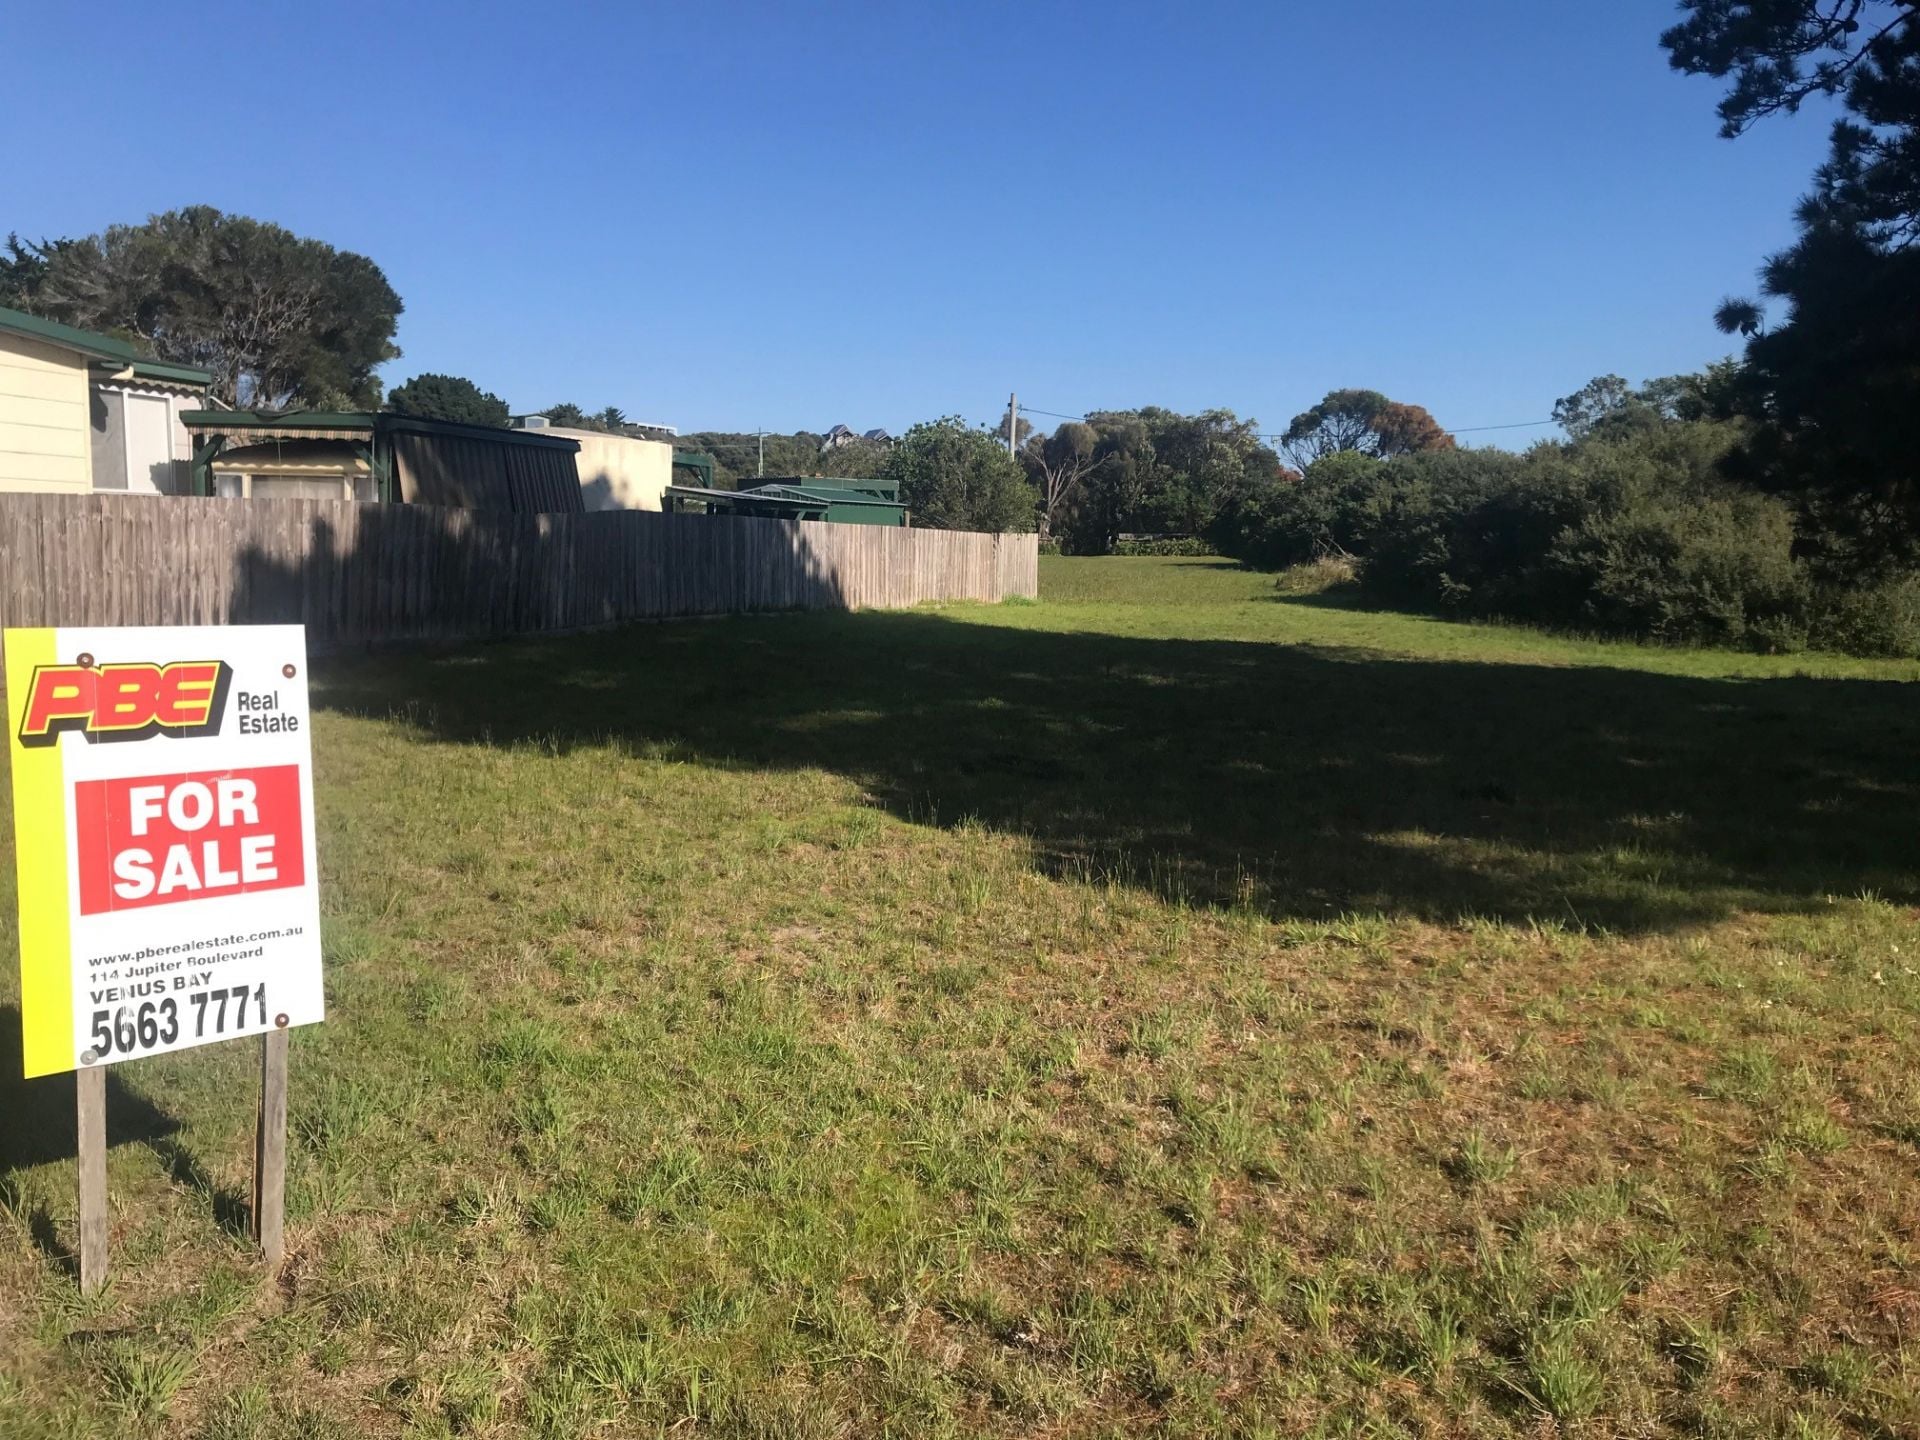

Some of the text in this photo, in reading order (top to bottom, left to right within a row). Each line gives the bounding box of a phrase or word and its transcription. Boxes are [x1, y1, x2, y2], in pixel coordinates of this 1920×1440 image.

[18, 660, 233, 748] PBE
[237, 690, 279, 712] Real
[239, 712, 299, 735] Estate
[129, 778, 260, 837] FOR
[112, 834, 279, 900] SALE
[88, 926, 304, 967] www.pberealestate.com.au
[89, 946, 264, 984] 114 Jupiter Boulevard
[89, 971, 213, 1005] VENUS BAY
[90, 982, 267, 1058] 5663 7771
